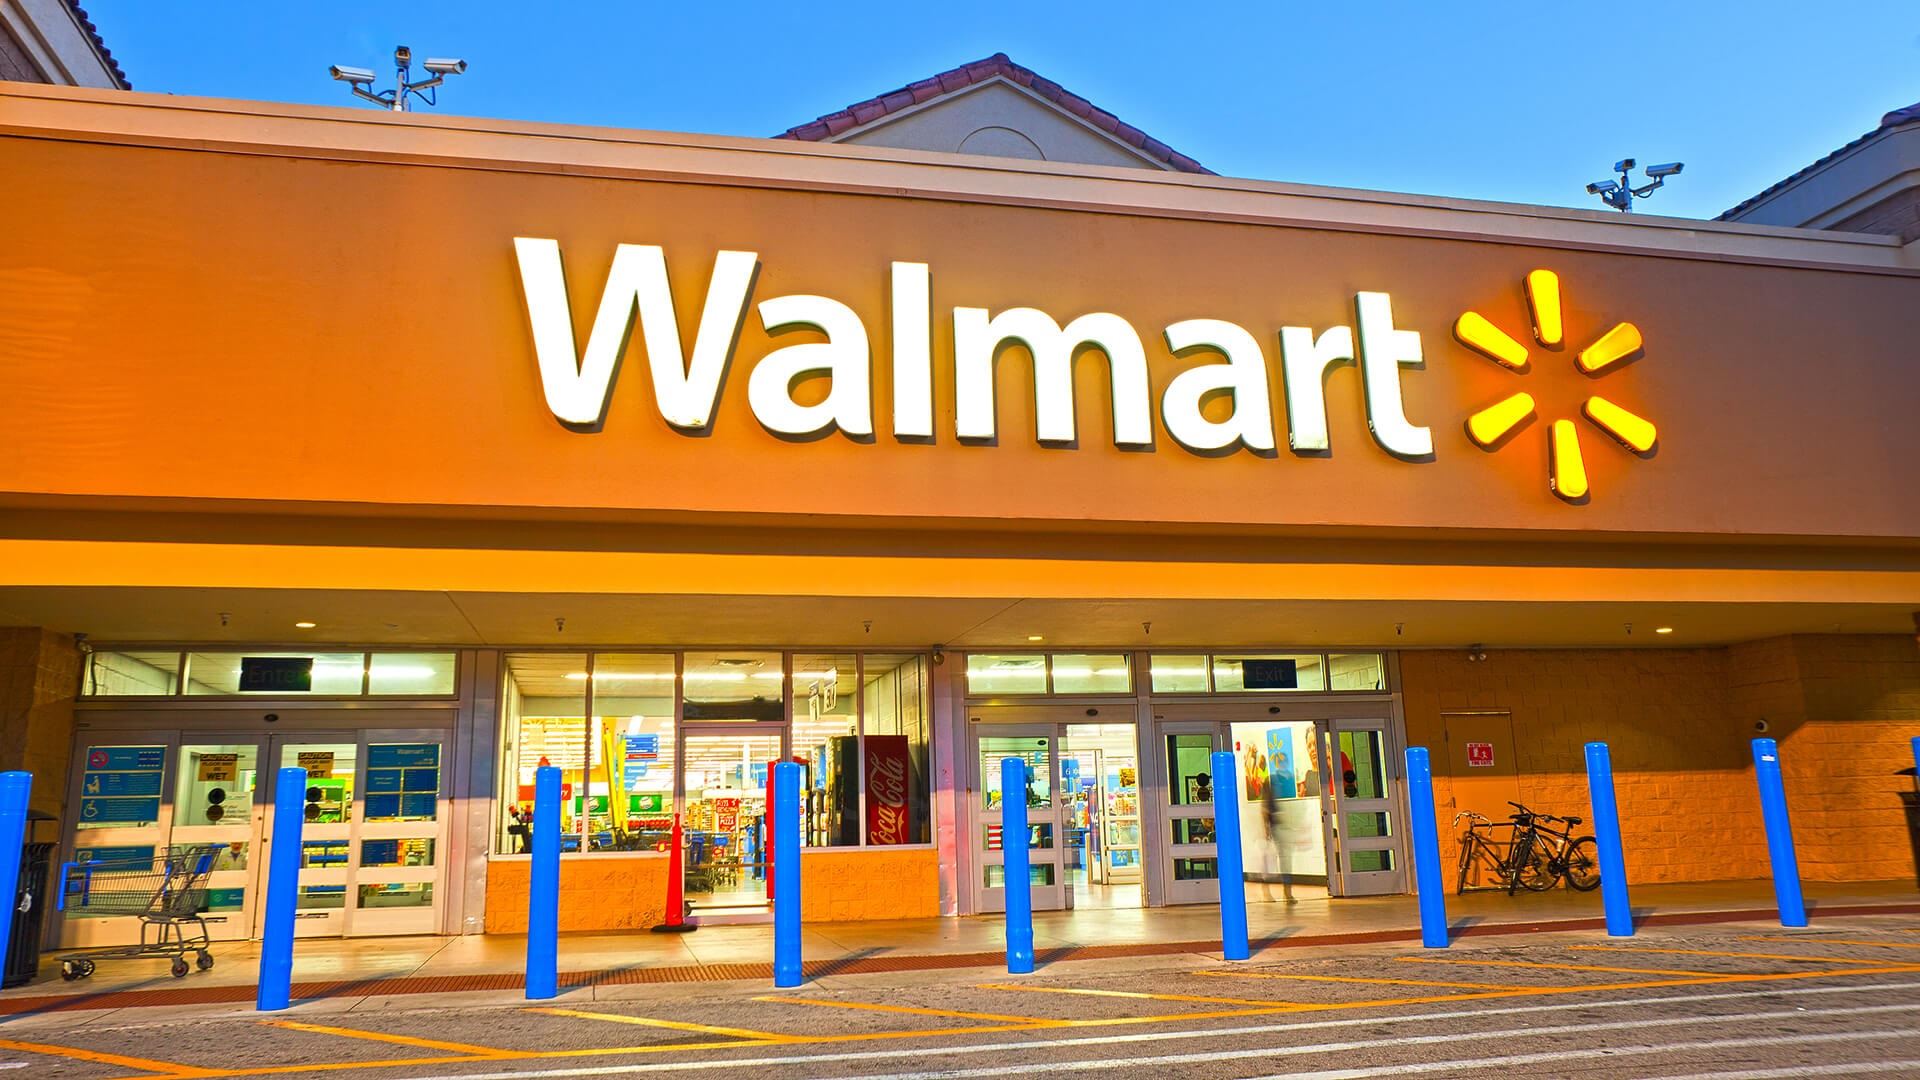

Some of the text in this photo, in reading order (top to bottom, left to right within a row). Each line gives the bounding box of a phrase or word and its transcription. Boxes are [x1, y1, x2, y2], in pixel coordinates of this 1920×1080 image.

[513, 237, 1433, 456] Walmart
[248, 665, 301, 683] Ente
[1255, 665, 1284, 682] Exit
[206, 772, 228, 780] WET
